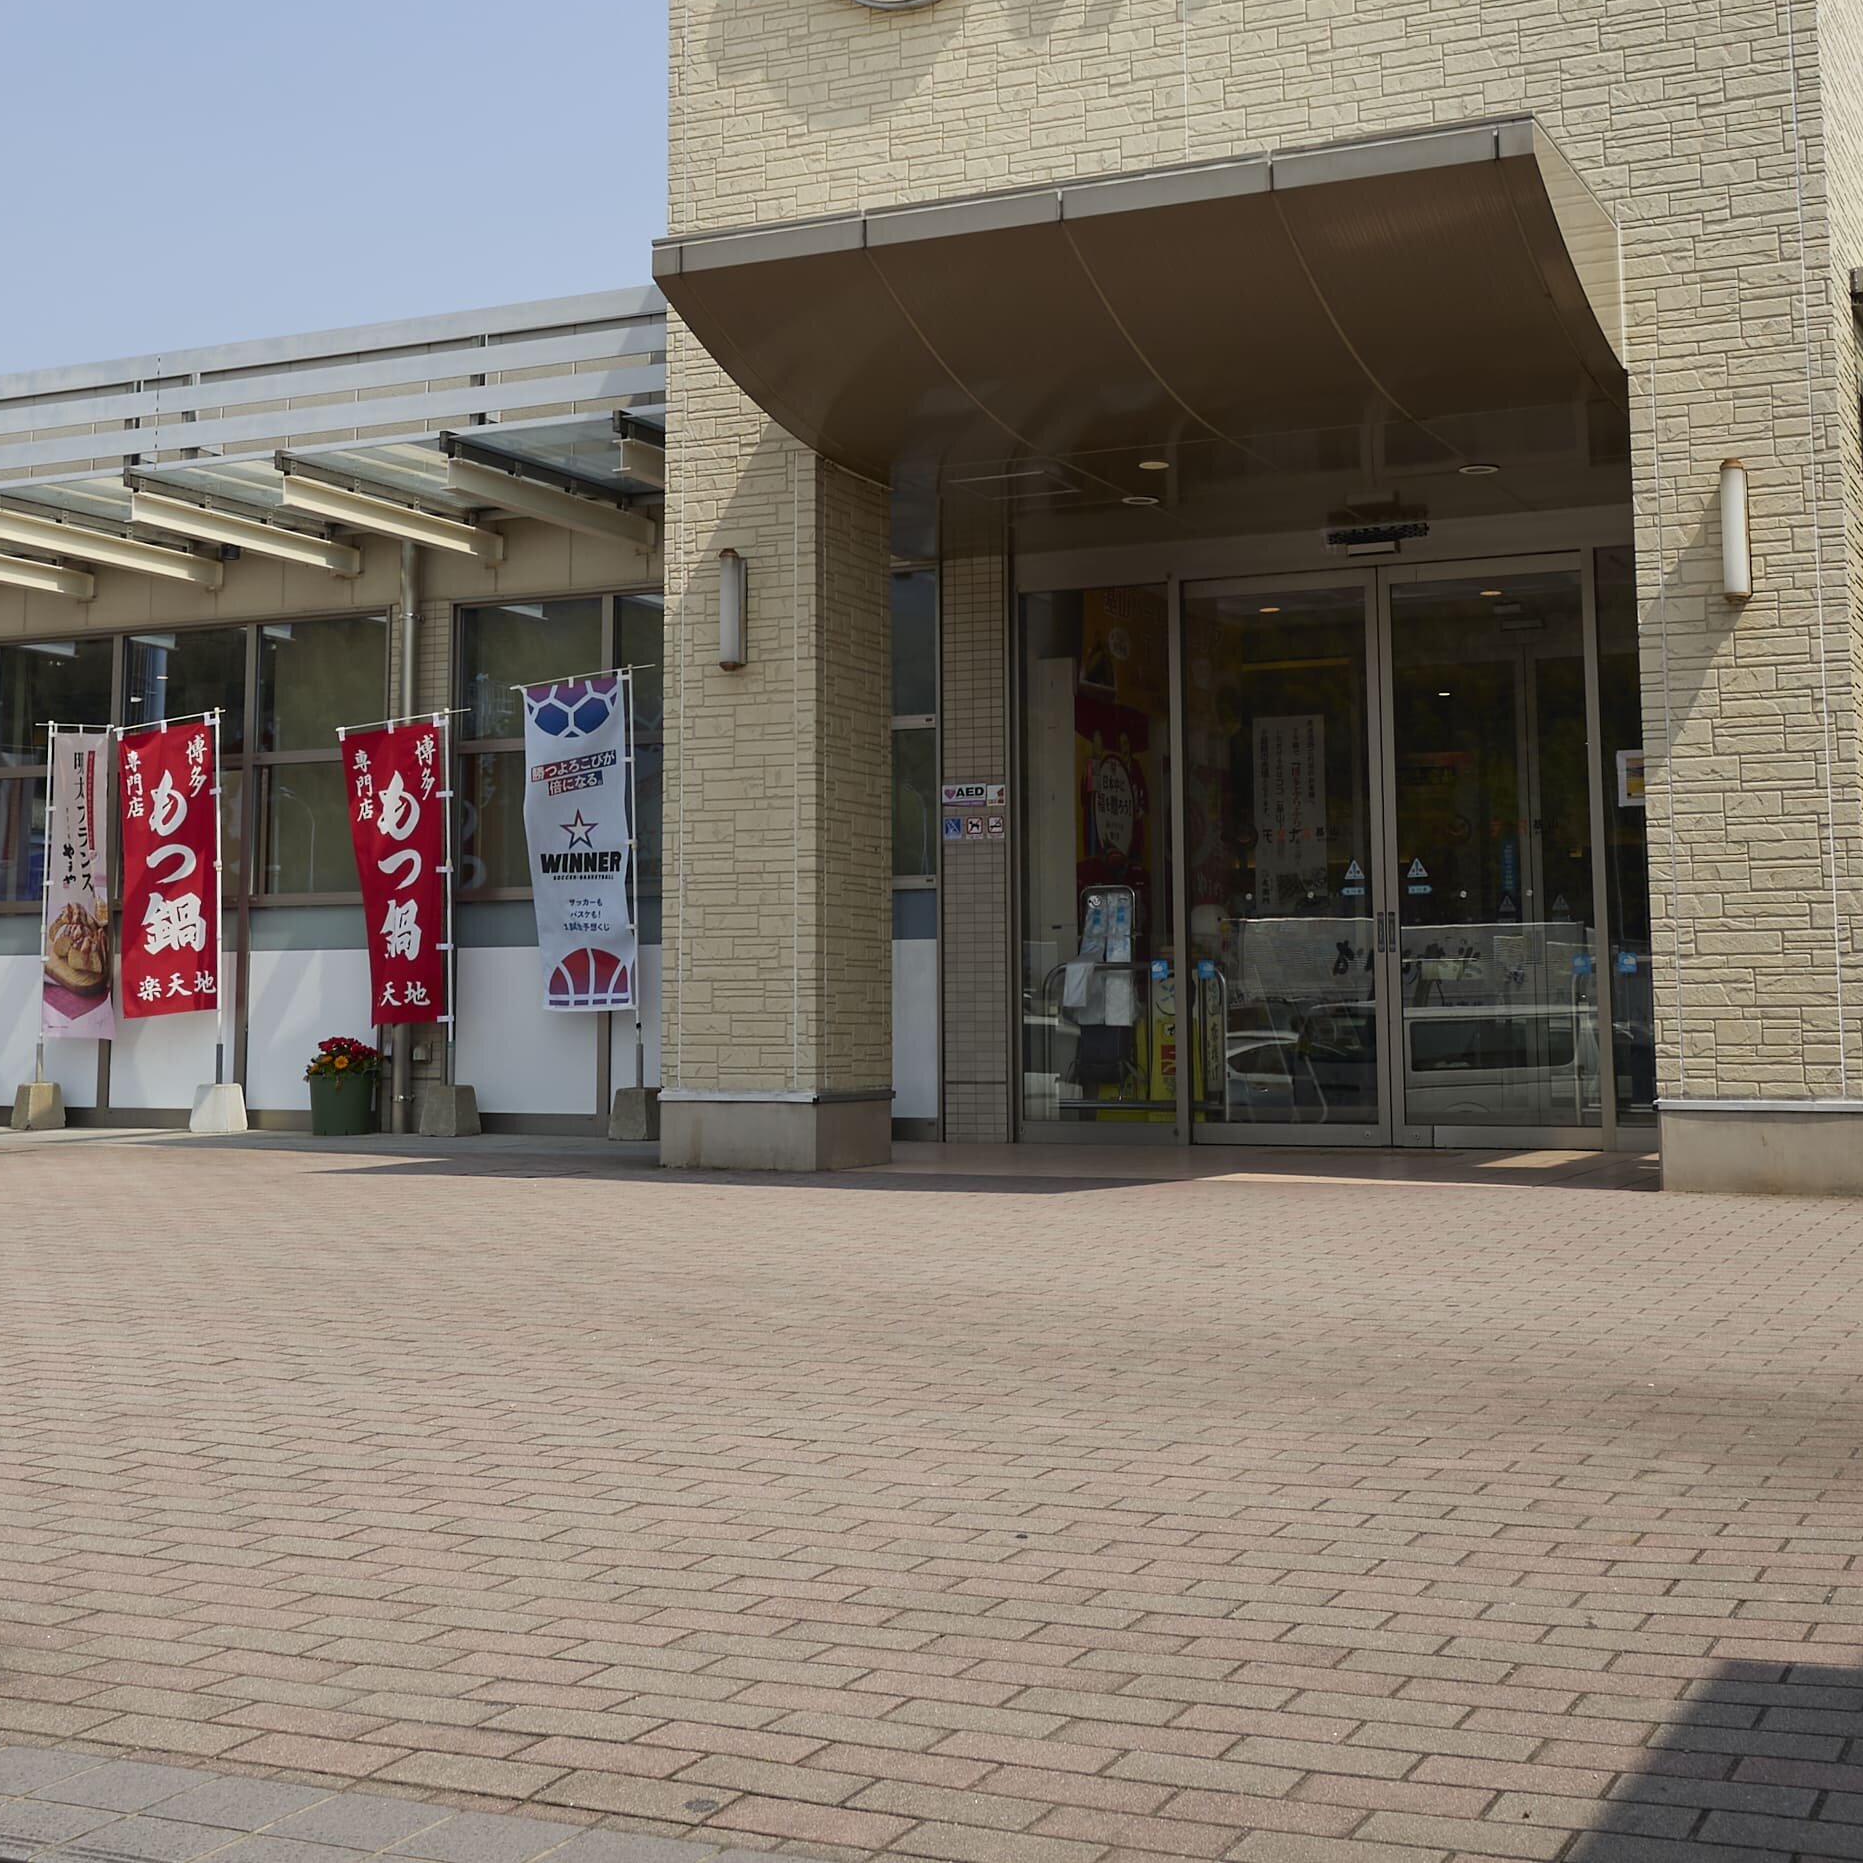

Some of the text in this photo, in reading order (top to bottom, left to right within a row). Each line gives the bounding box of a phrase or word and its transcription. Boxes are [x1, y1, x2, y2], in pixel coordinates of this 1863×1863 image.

[124, 751, 145, 819] 専門店
[186, 733, 208, 798] 博多
[353, 750, 374, 822] 専門店
[415, 733, 437, 801] 博多
[532, 751, 615, 781] 勝つよろこびが
[956, 787, 984, 797] AED
[142, 769, 207, 955] もつ鍋
[377, 770, 422, 961] もつ鍋
[540, 851, 622, 874] WINNER
[137, 970, 217, 1002] 楽天地
[378, 980, 431, 1007] 天地
